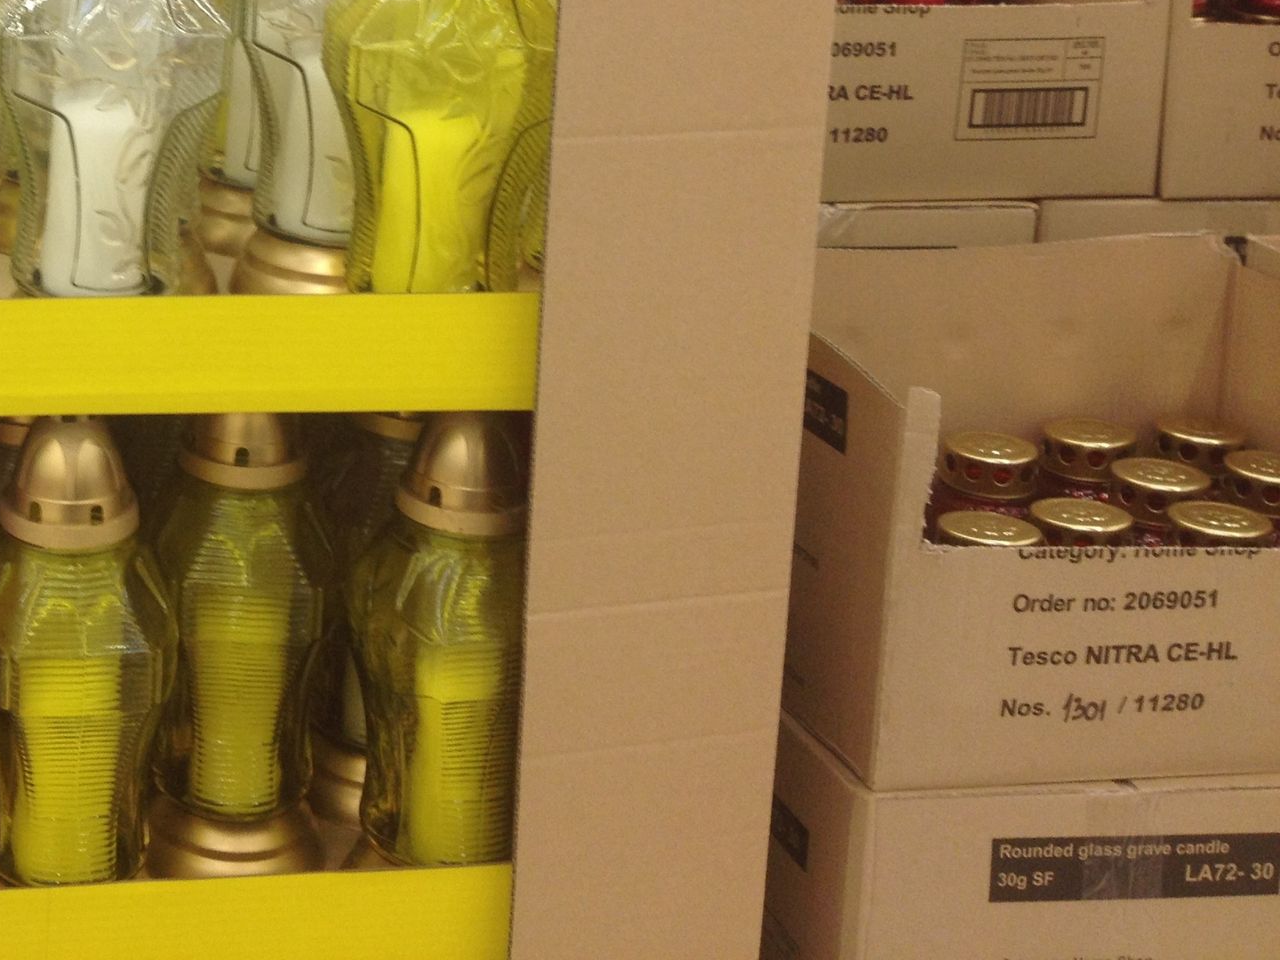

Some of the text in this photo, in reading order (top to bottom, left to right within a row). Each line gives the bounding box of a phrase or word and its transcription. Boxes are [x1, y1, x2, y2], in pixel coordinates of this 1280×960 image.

[854, 83, 915, 101] CE-HL
[1013, 589, 1219, 614] Order no: 2069051
[1007, 640, 1239, 667] Tesco NITRA CE-HL
[1000, 698, 1051, 718] Nos.
[1135, 692, 1205, 713] 11280
[999, 840, 1231, 861] Rounded glass grave candle
[997, 871, 1055, 891] 30g SF
[1250, 861, 1276, 881] 30
